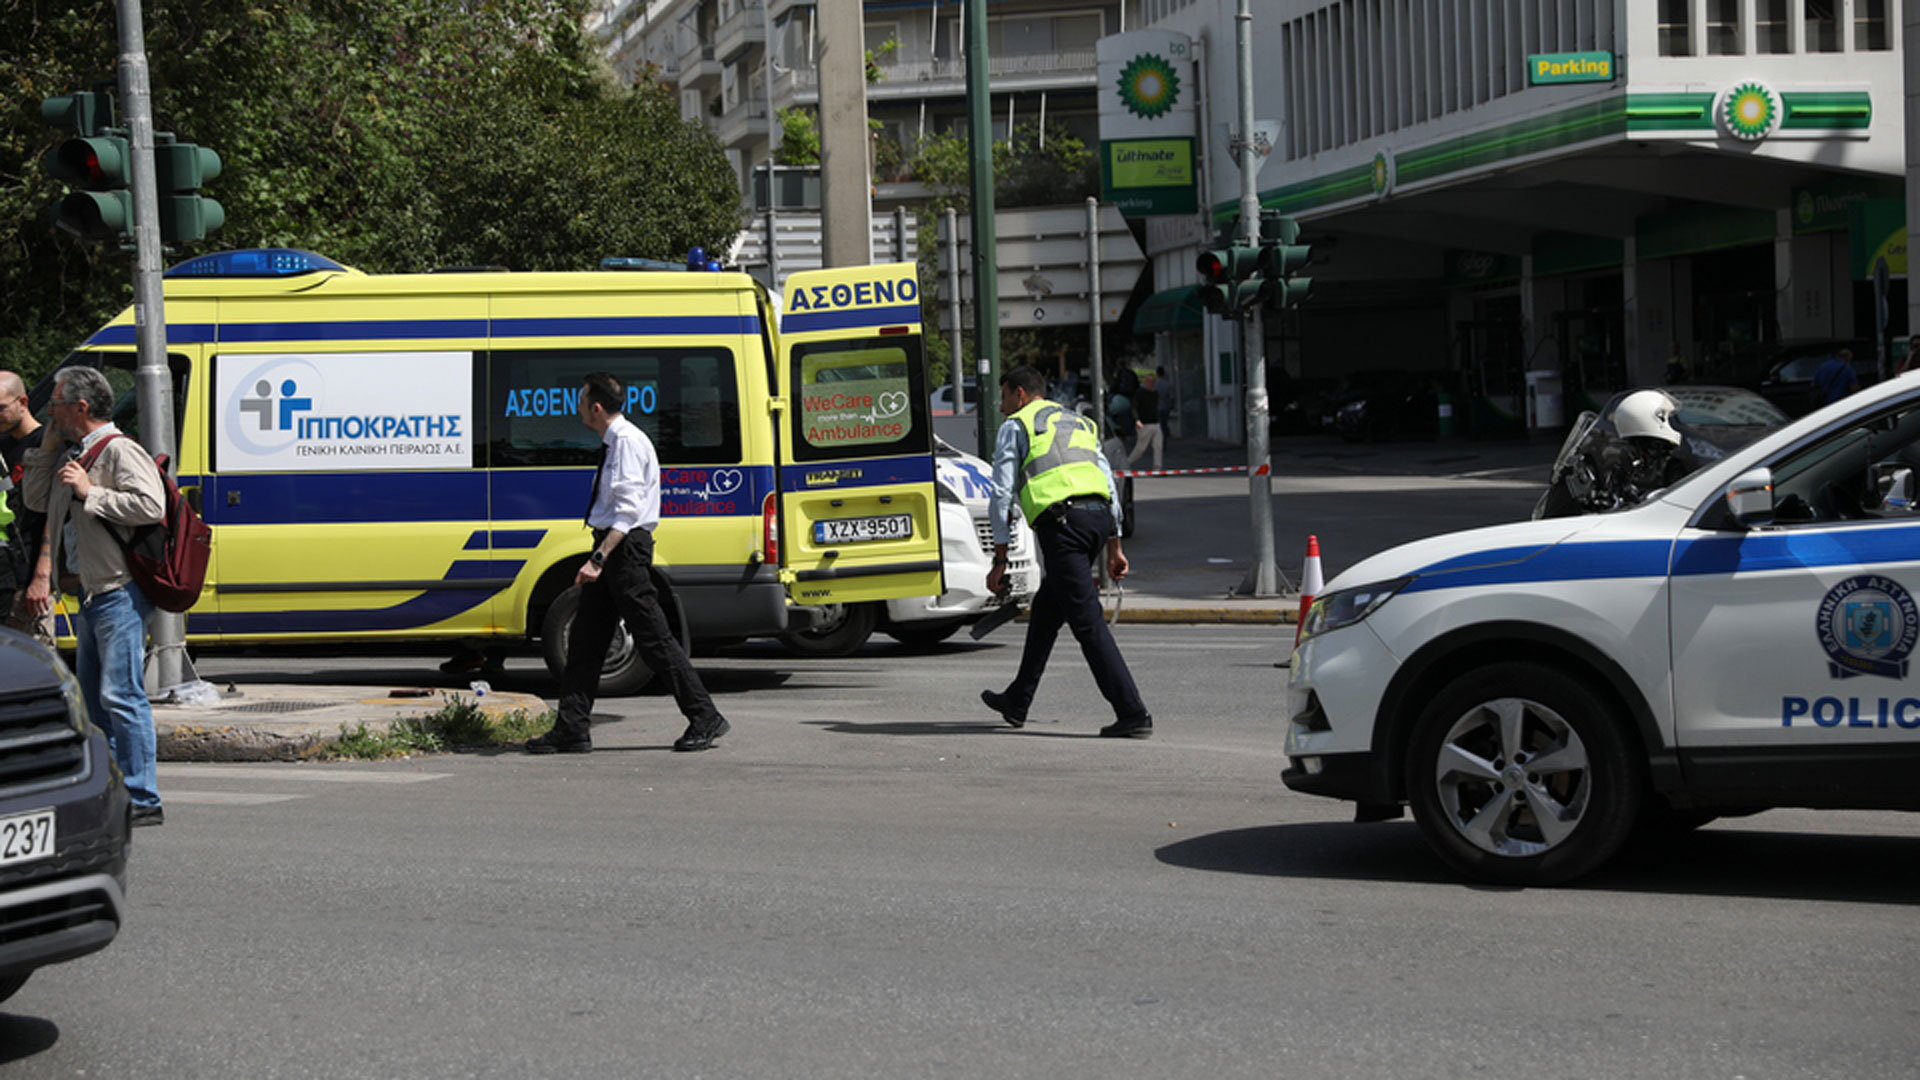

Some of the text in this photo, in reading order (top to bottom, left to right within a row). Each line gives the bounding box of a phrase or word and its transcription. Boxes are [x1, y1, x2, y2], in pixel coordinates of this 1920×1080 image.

[1169, 41, 1186, 56] bp
[1537, 56, 1610, 78] Parking
[1113, 197, 1153, 209] arking
[789, 278, 918, 311] ΑΣΘΕΝΟ
[505, 386, 656, 417] ΑΣΘΕΝΡΟ
[803, 392, 873, 412] WeCare
[297, 414, 462, 440] ΙΠΠΟΚΡΑΤΗΣ
[817, 412, 858, 422] more than
[807, 423, 904, 443] Ambulance
[296, 443, 465, 456] ΓΕΝΙΚΗ ΚΛΙΝΙΚΗ ΠΕΙΡΑΙΩΣ Α.Ε.
[1819, 576, 1918, 653] ΕΛΛΗΝΙΚΗ ΑΣΤΥΝΟΜΙΑ
[3, 817, 50, 858] 237
